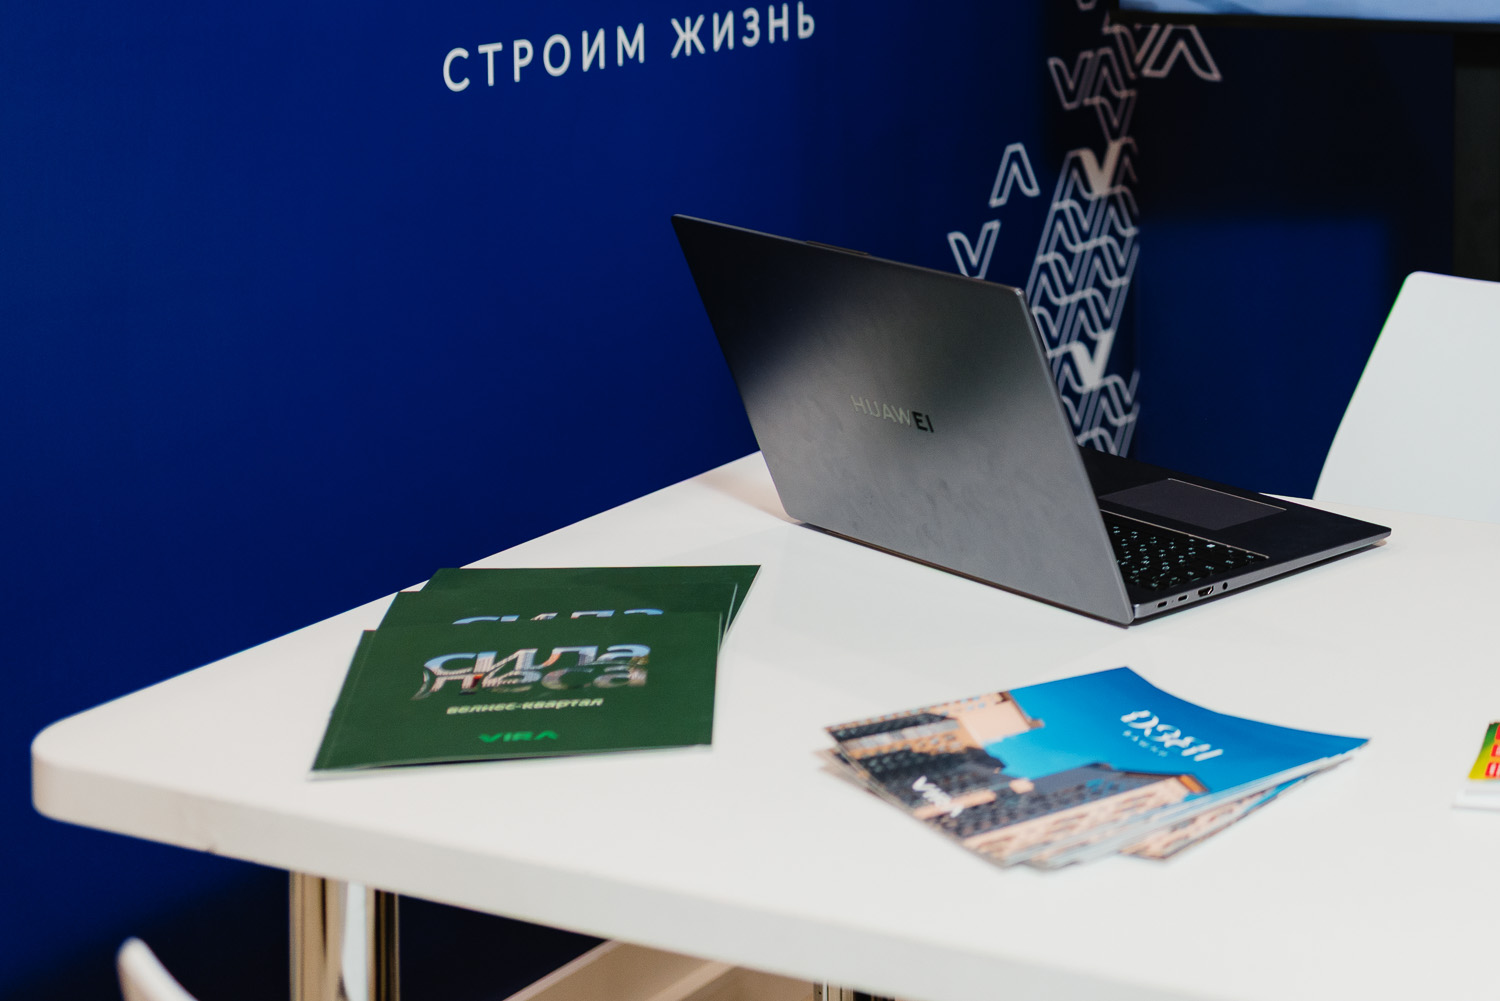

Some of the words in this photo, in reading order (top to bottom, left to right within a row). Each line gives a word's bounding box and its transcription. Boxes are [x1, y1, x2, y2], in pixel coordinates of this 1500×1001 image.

[442, 23, 646, 93] СТРОИМ
[670, 2, 816, 60] ЖИЗНЬ
[850, 394, 935, 434] HUAWEI
[478, 730, 559, 743] VIRA
